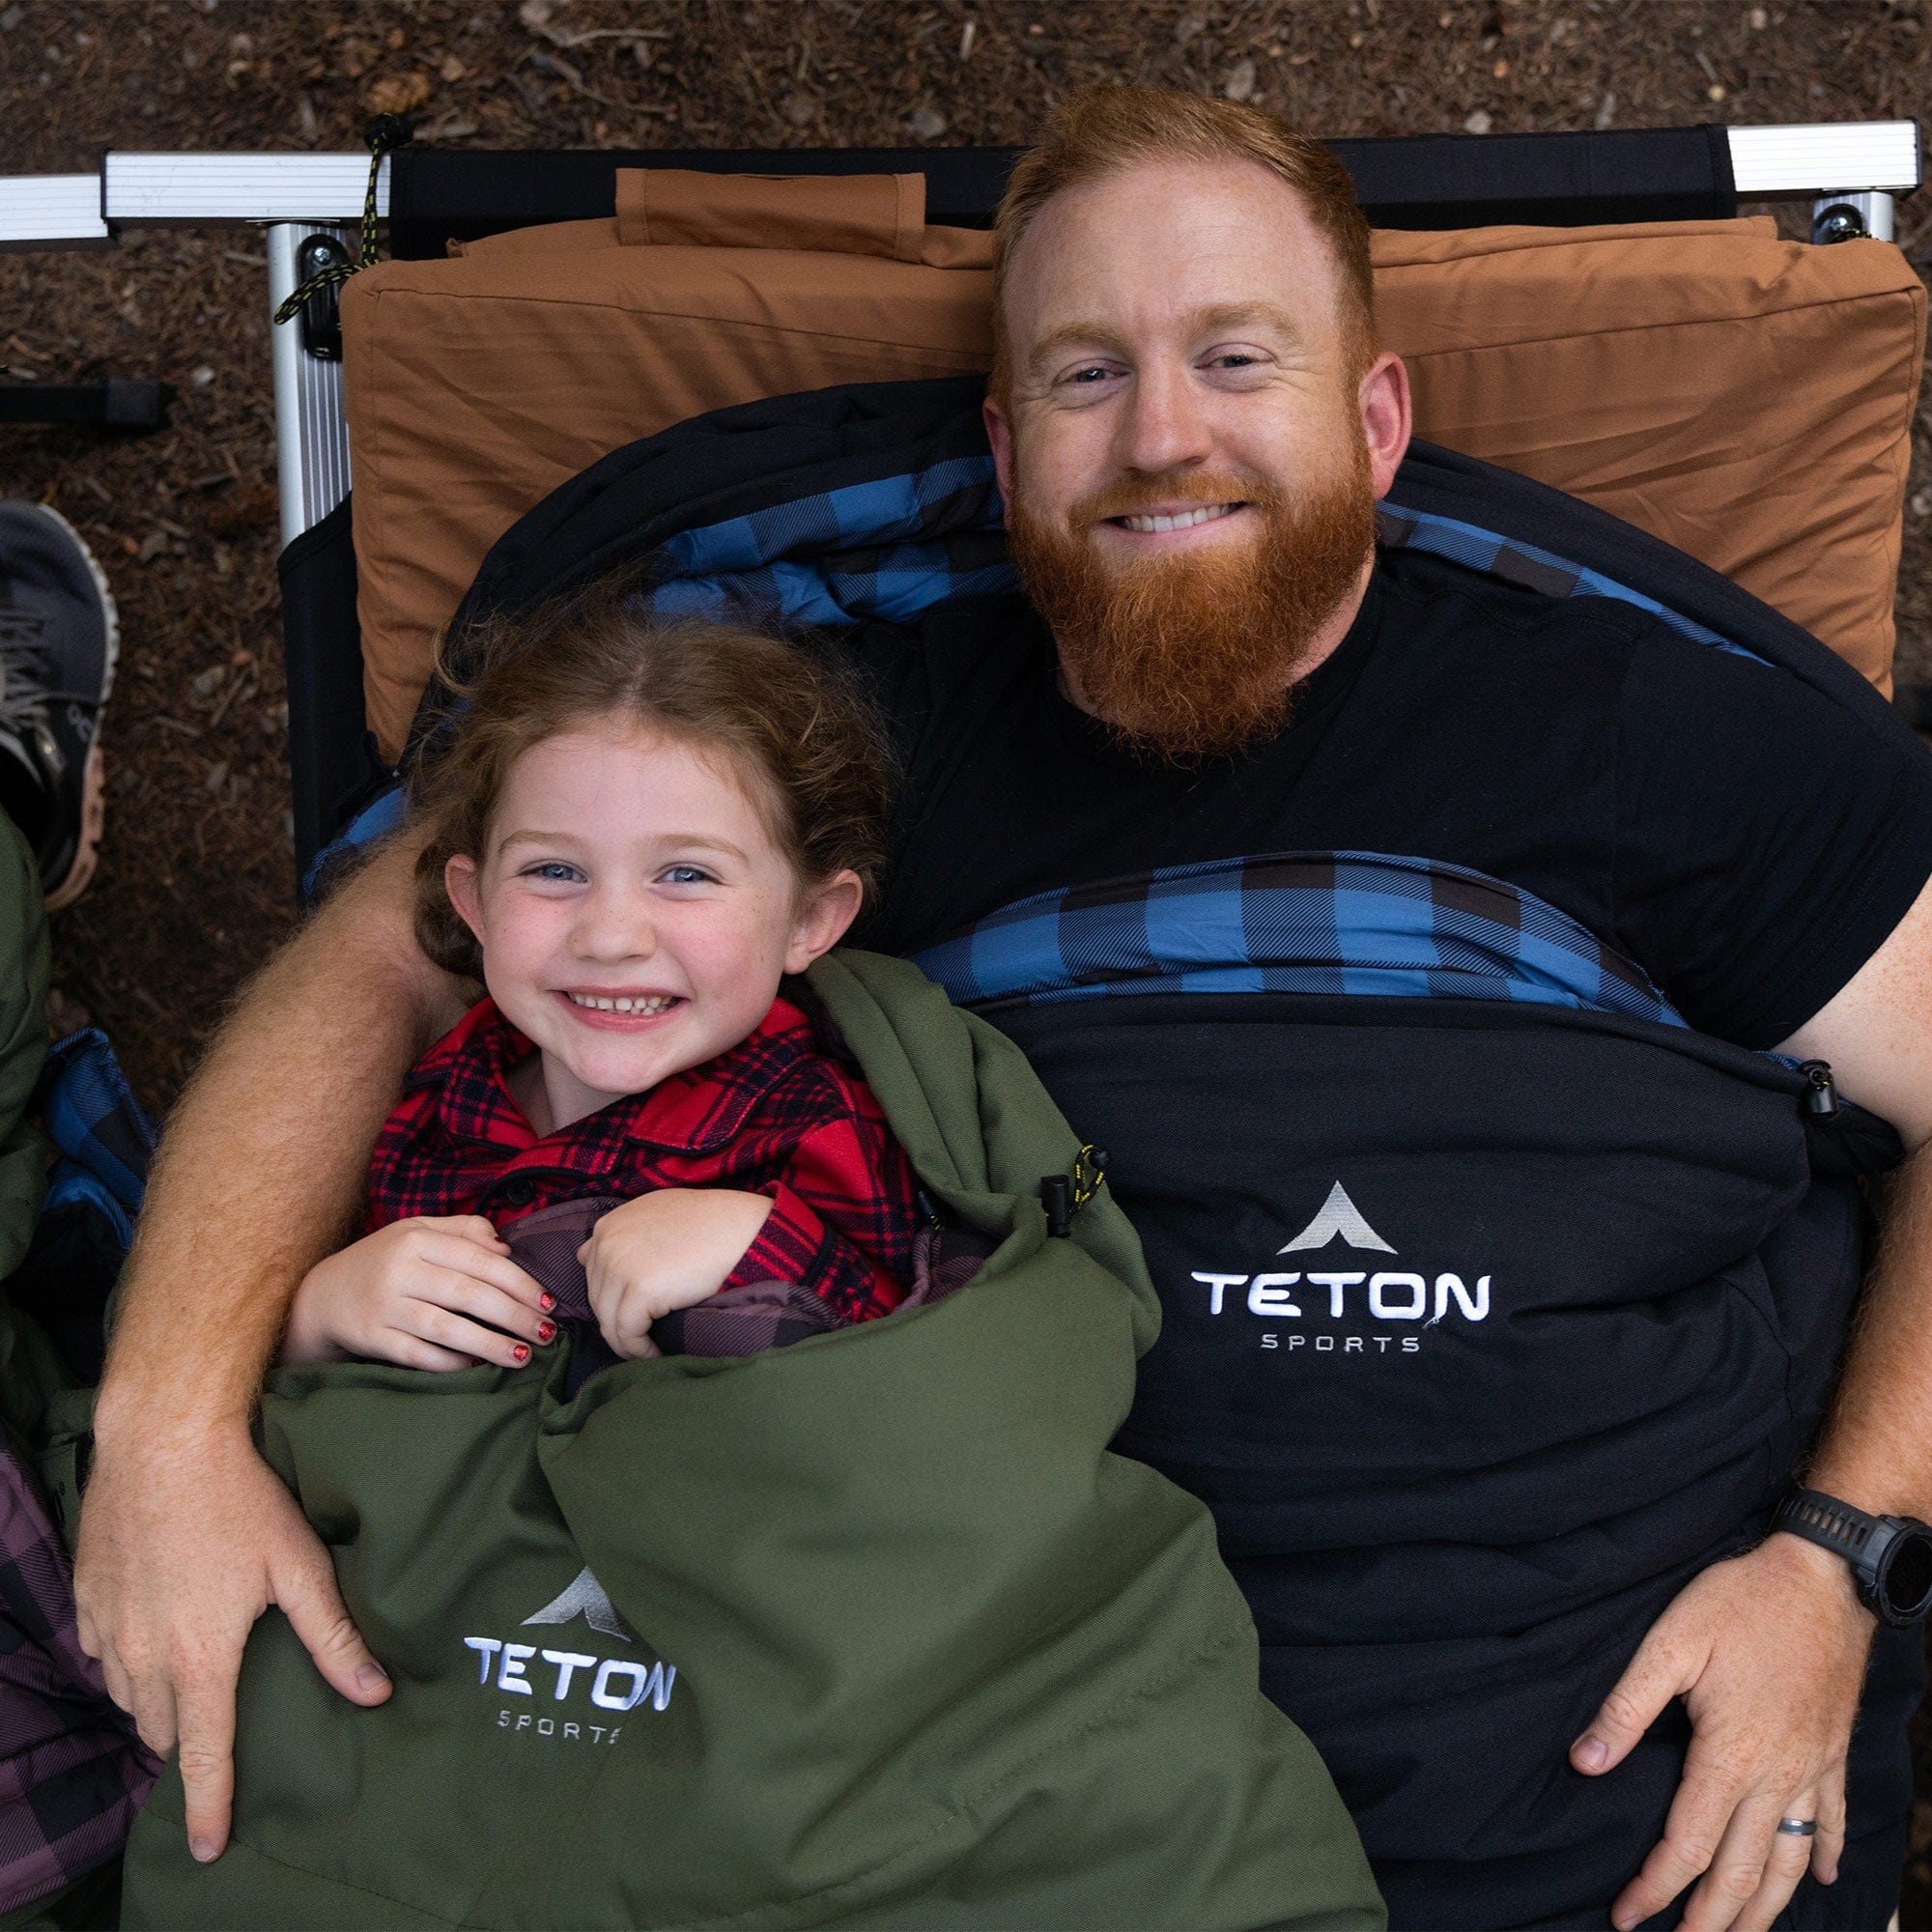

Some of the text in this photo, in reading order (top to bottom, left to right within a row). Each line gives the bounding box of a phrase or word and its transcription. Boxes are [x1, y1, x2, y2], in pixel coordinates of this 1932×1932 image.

[1190, 1271, 1492, 1322] TETON
[1260, 1333, 1420, 1353] SPORTS
[463, 1636, 677, 1712] TETON
